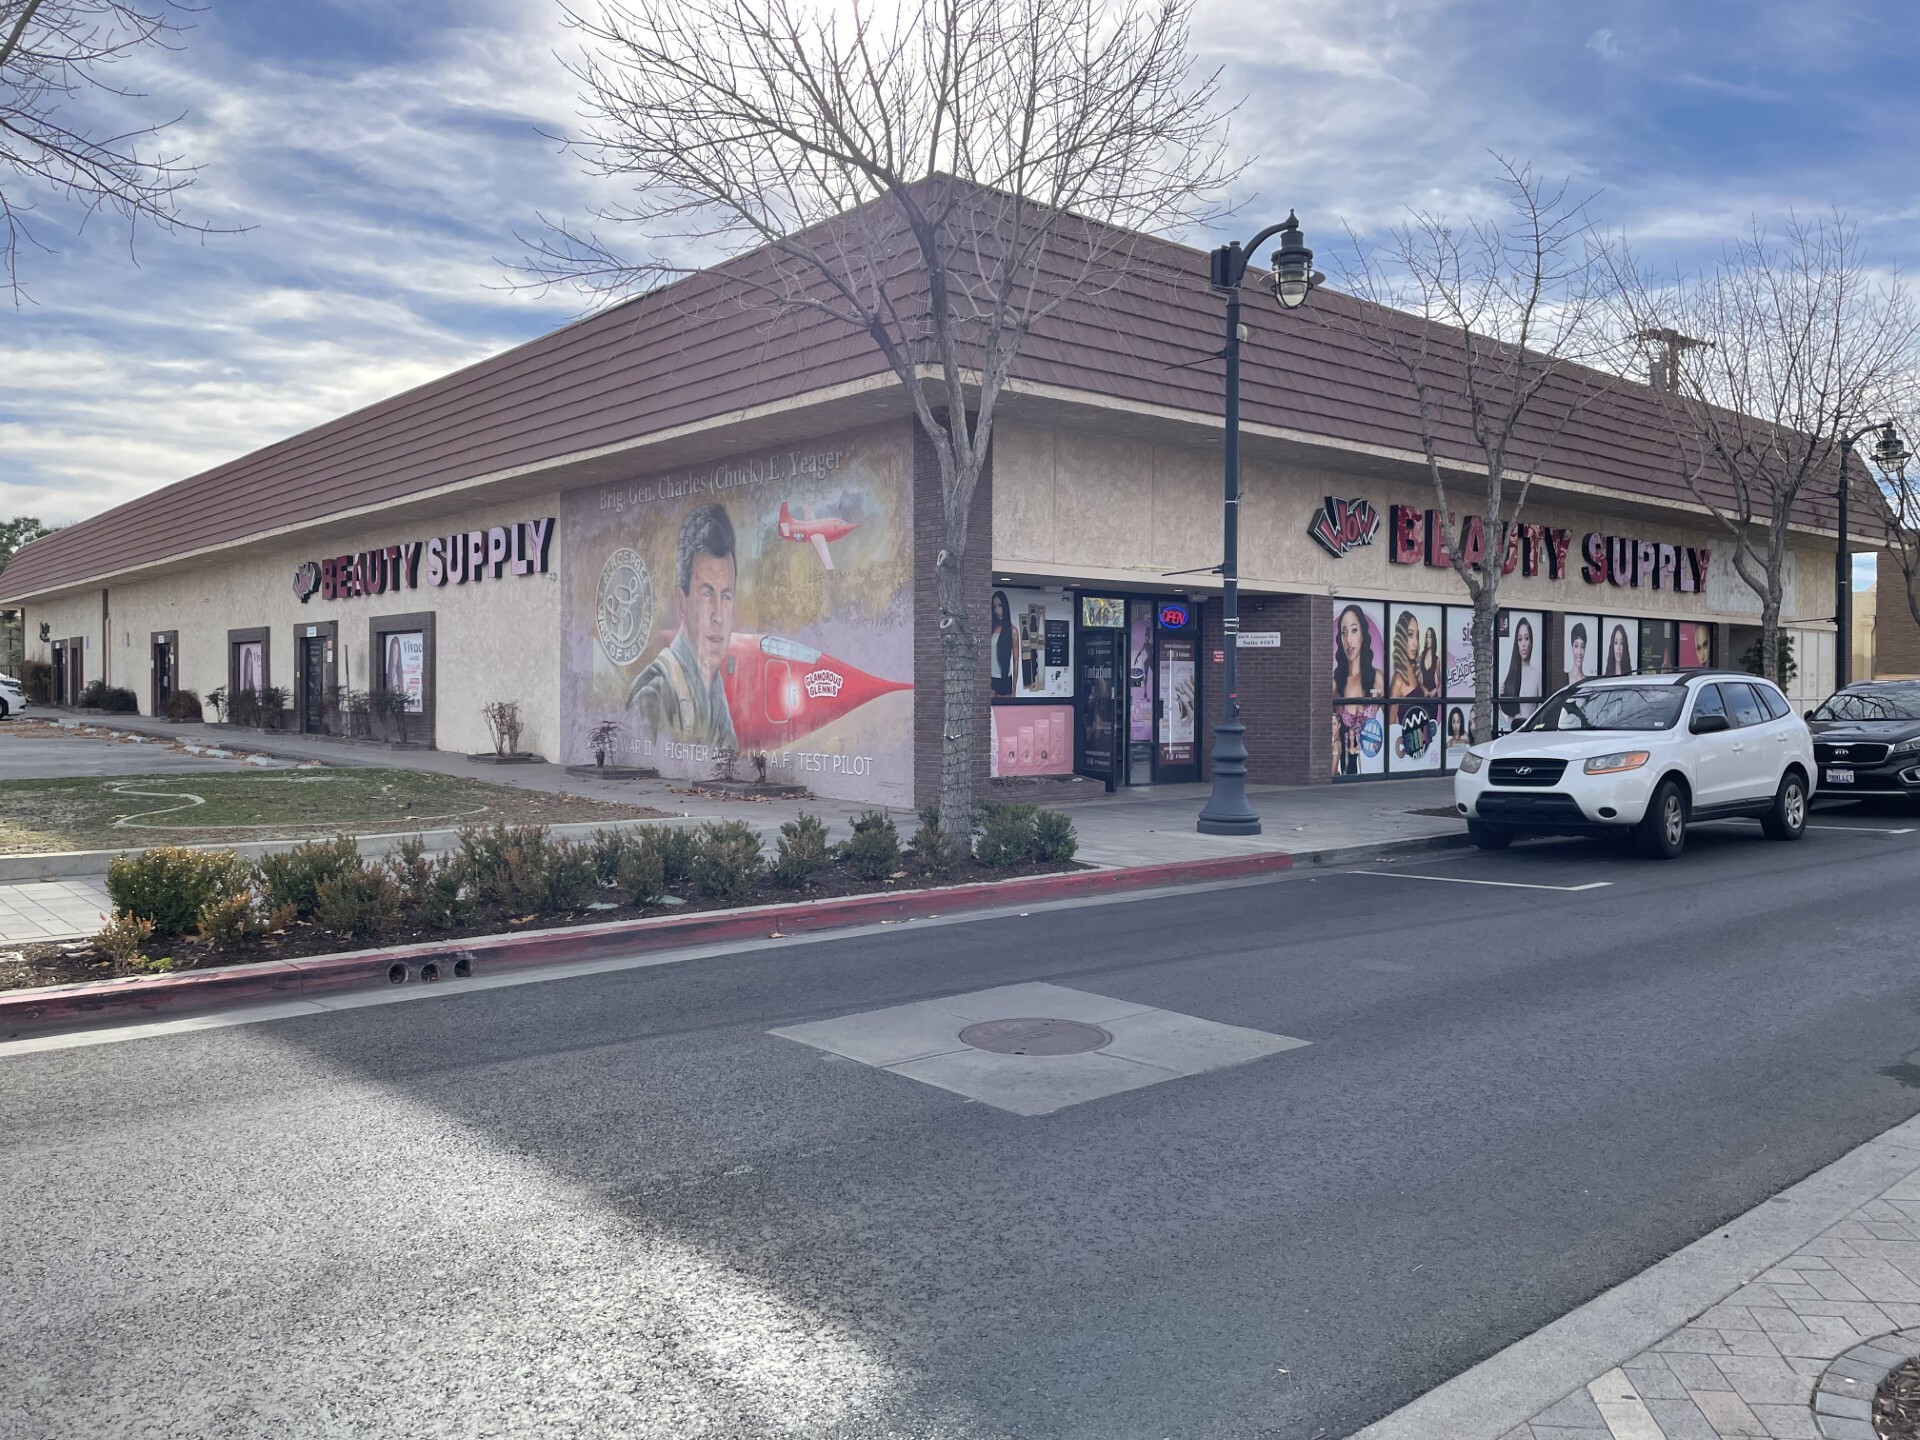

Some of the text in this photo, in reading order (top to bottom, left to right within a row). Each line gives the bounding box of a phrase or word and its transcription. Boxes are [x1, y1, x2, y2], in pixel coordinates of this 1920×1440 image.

[600, 450, 842, 512] Brig. Gen. Charles (Chuck) E. Yeager
[322, 541, 422, 600] BEAUTY
[427, 517, 555, 587] SUPPLY
[1581, 532, 1711, 593] SUPPLY
[1162, 610, 1185, 625] OPEN
[806, 671, 842, 687] GLAMOROUS
[810, 685, 836, 695] GLENNIS
[620, 739, 641, 755] WAR
[665, 742, 709, 761] FIGHTER
[798, 752, 829, 772] TEST
[833, 754, 873, 776] PILOT
